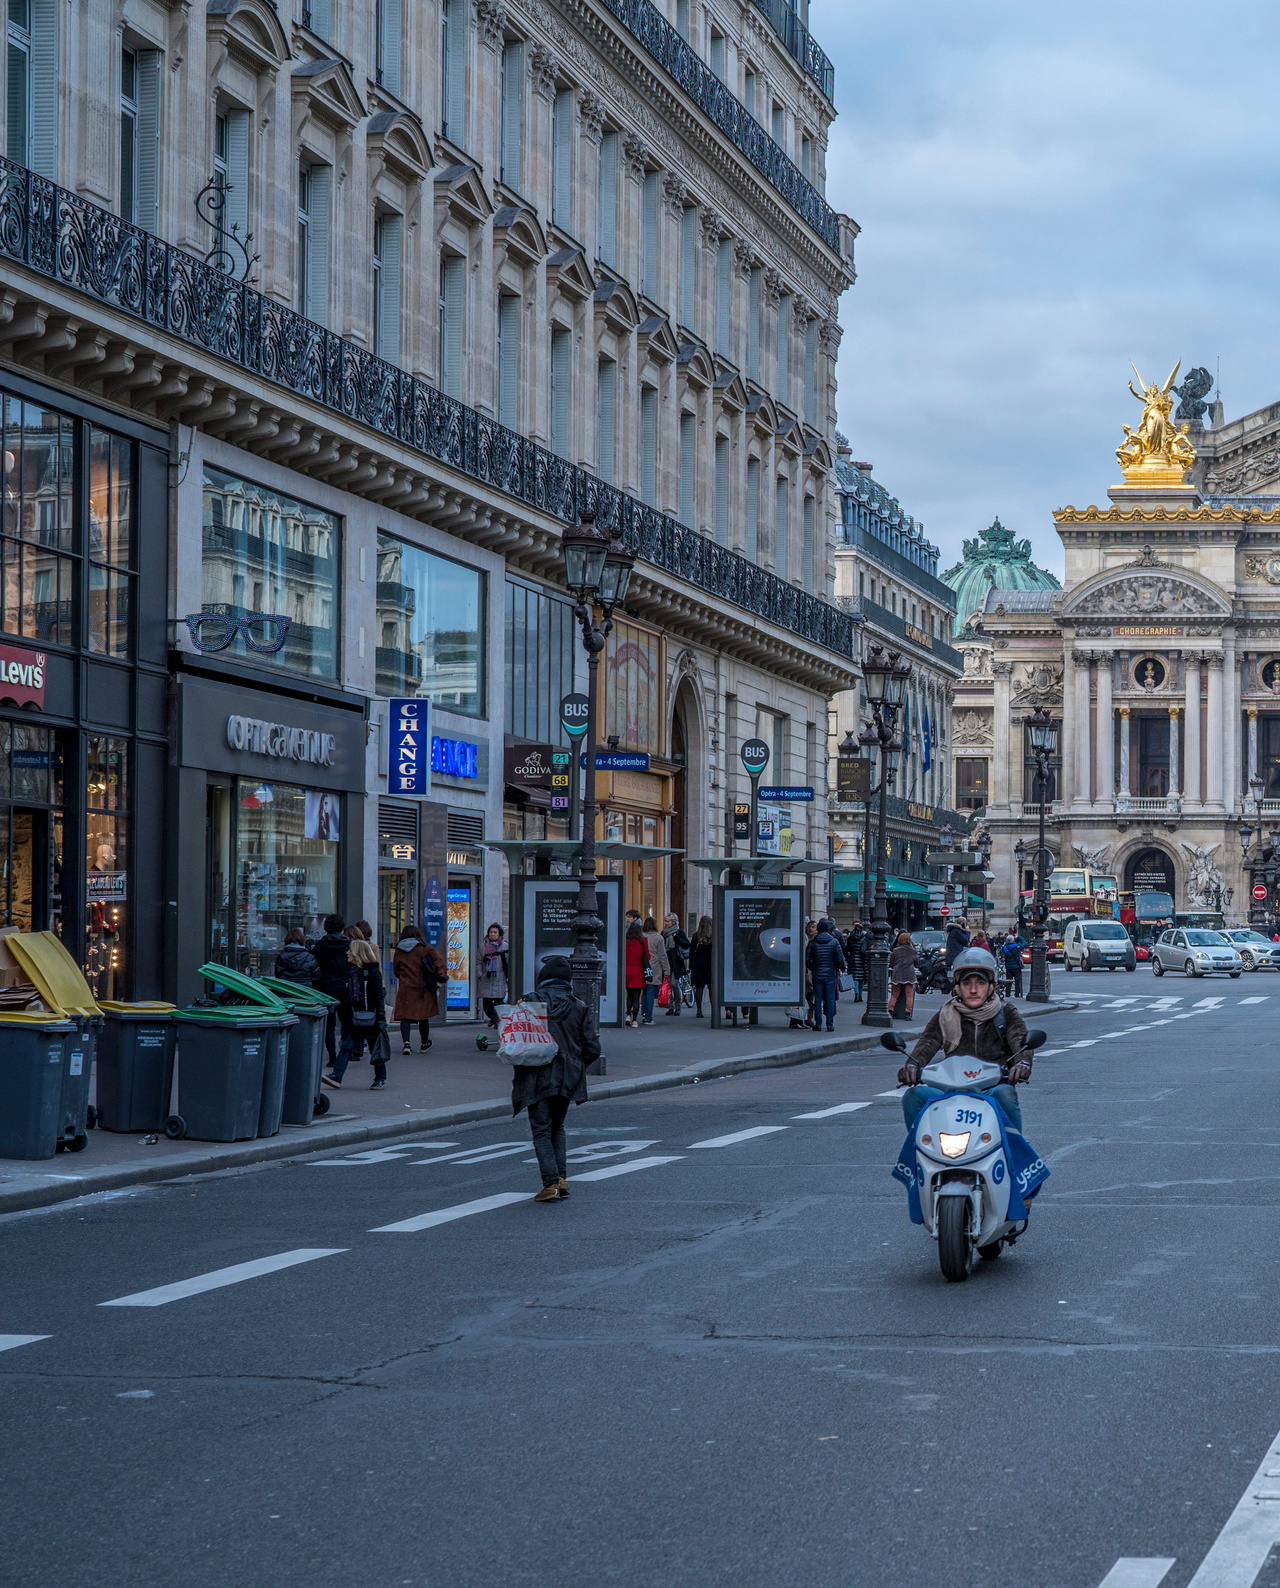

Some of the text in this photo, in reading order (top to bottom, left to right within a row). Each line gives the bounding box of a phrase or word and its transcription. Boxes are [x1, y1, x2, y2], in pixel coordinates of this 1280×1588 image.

[564, 703, 589, 716] BUS
[398, 704, 420, 790] CHANGE
[745, 746, 765, 758] BUS
[430, 736, 478, 779] ANGE
[554, 754, 566, 764] 21
[612, 758, 646, 766] Septembre
[514, 766, 552, 774] GODIVA
[554, 776, 567, 786] 68
[554, 798, 566, 806] 81
[447, 920, 467, 932] ppy
[447, 954, 466, 970] ar!
[955, 1109, 983, 1128] 3191
[1016, 1158, 1044, 1192] ysco
